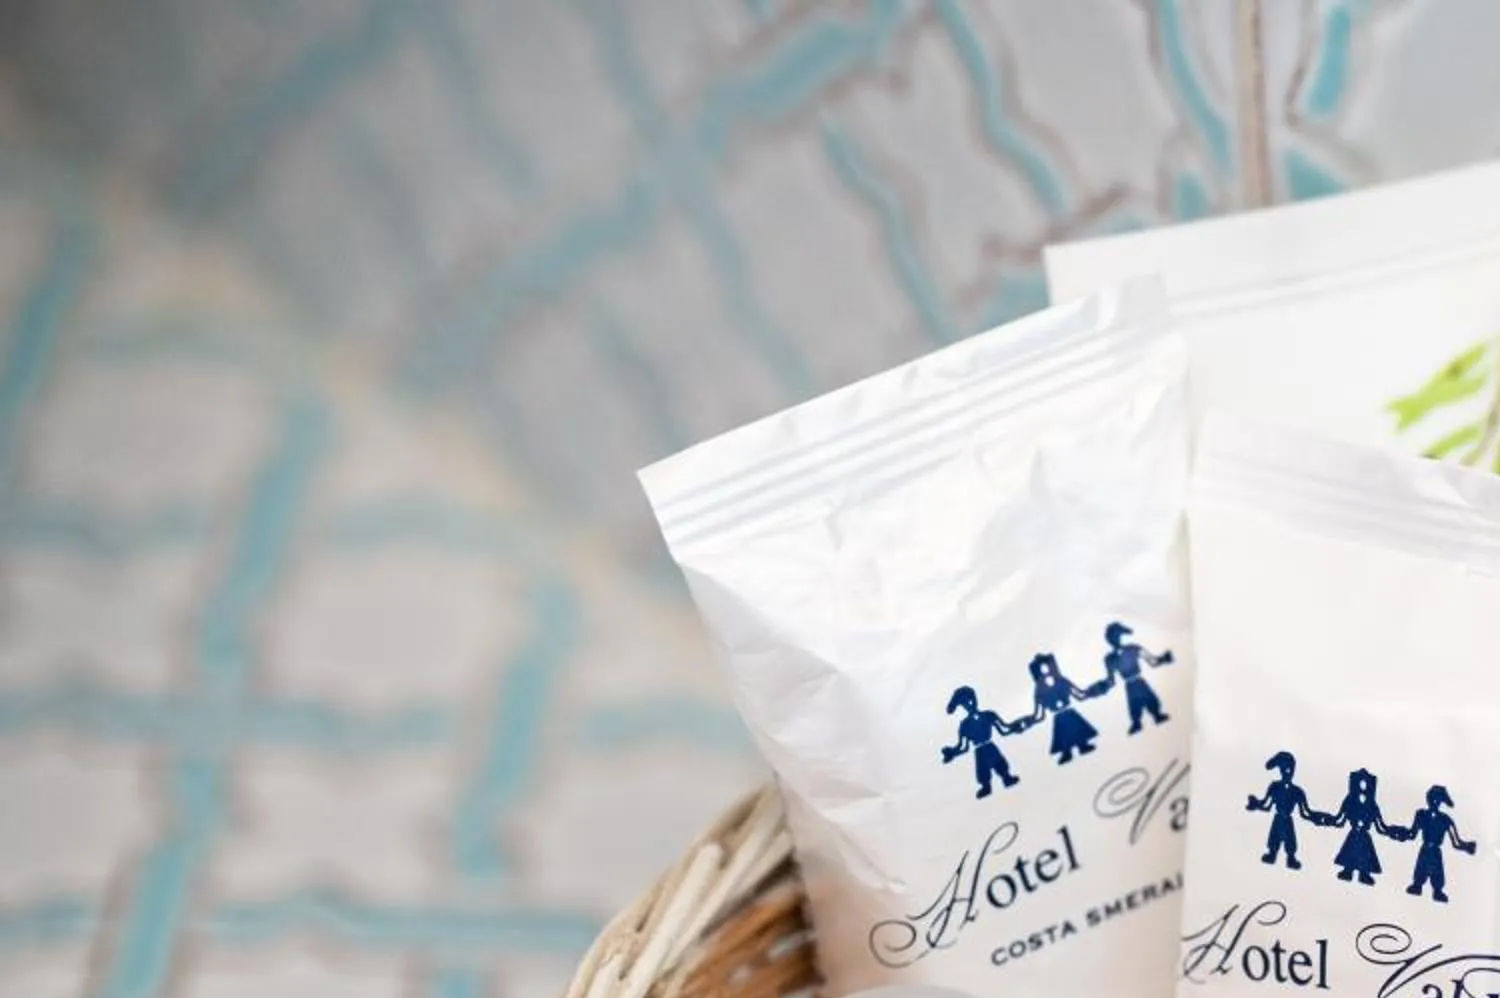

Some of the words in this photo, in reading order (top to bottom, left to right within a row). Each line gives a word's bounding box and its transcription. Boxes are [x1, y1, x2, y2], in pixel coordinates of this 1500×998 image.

[869, 821, 1082, 969] Hotel
[1093, 757, 1190, 845] Va
[990, 918, 1078, 966] COSTA
[1180, 901, 1332, 988] Hotel
